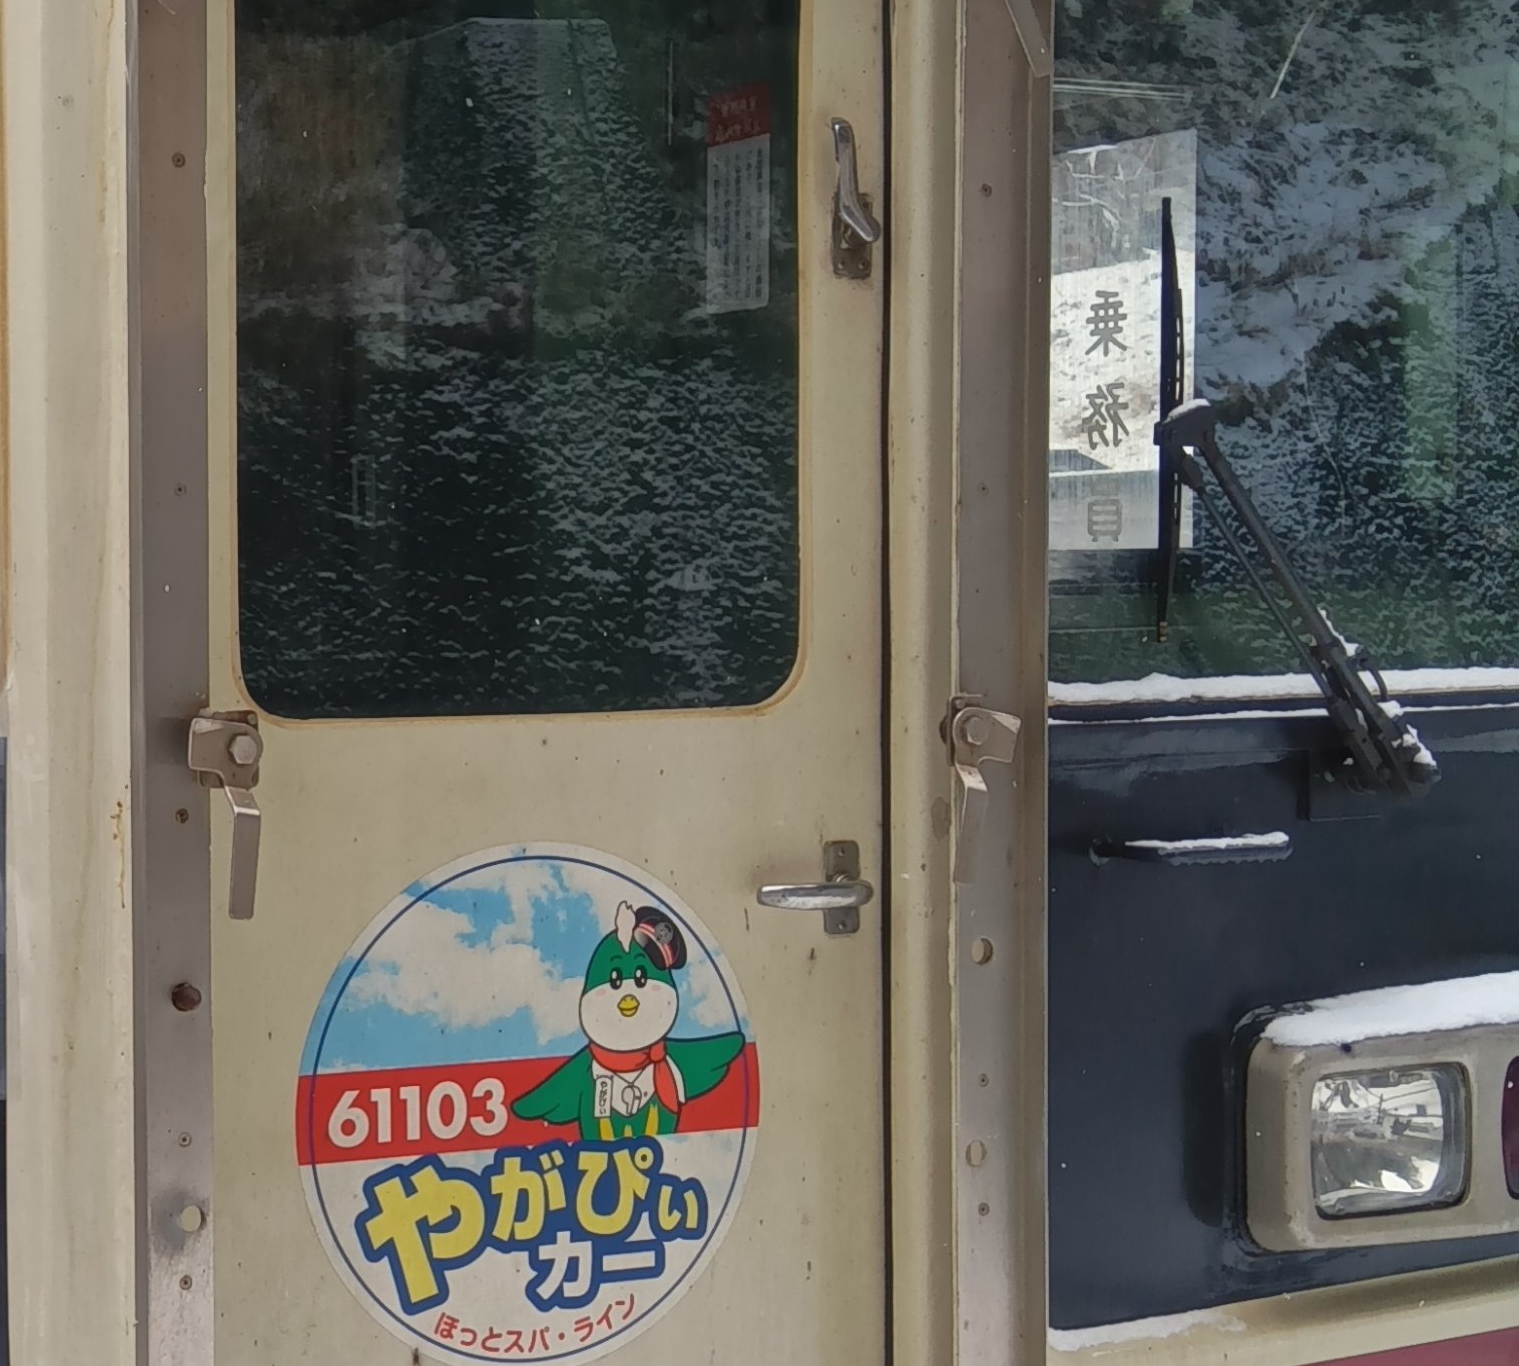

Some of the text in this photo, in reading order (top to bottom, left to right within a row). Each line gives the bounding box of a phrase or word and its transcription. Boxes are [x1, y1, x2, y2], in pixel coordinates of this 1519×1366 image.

[326, 1076, 509, 1151] 61103
[536, 1231, 657, 1302] カー
[434, 1292, 636, 1354] ほっとスパ・ライン
